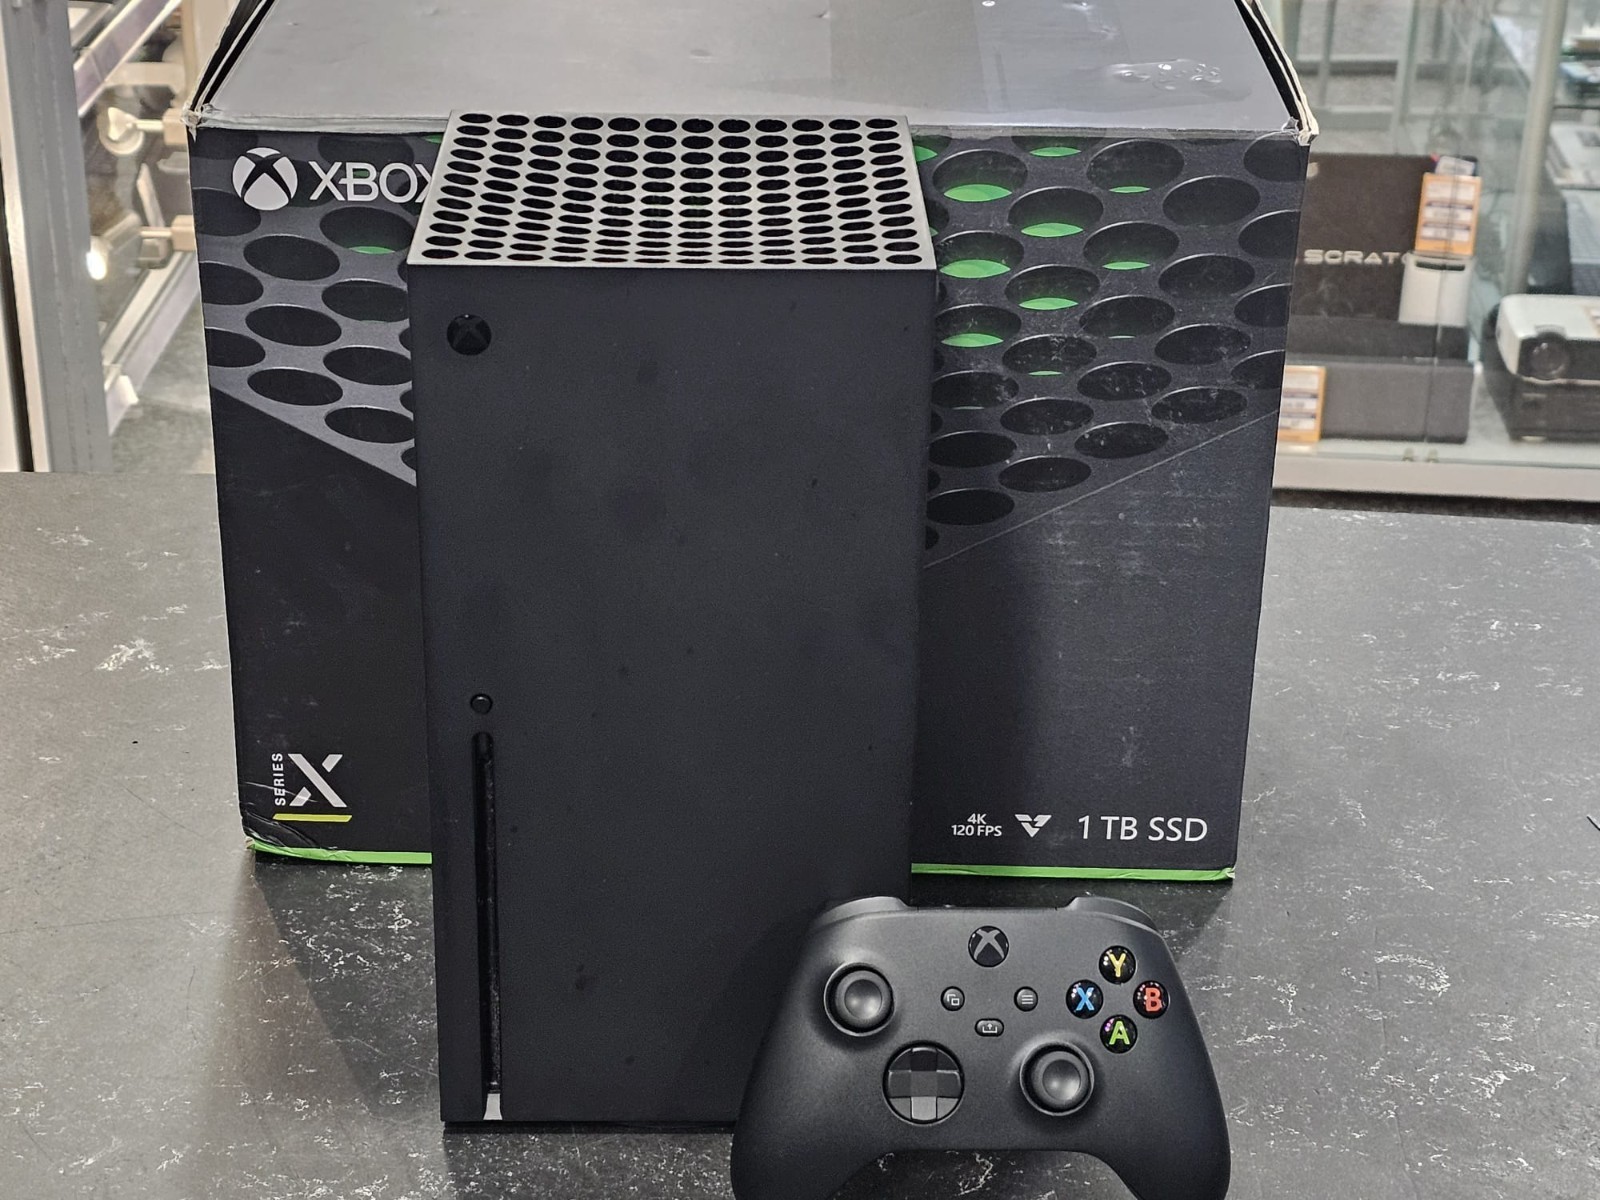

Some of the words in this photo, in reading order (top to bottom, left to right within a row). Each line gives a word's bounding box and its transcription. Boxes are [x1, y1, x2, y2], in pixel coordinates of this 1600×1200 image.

[271, 753, 286, 806] SERIES
[951, 825, 975, 836] 120
[977, 825, 1002, 837] FPS
[967, 813, 987, 825] 4K
[1078, 815, 1090, 840] 1
[1100, 816, 1138, 841] TB
[1148, 817, 1208, 842] SSD
[1109, 953, 1126, 977] Y
[1076, 987, 1095, 1011] X
[1145, 987, 1162, 1012] B
[1109, 1021, 1130, 1045] A
